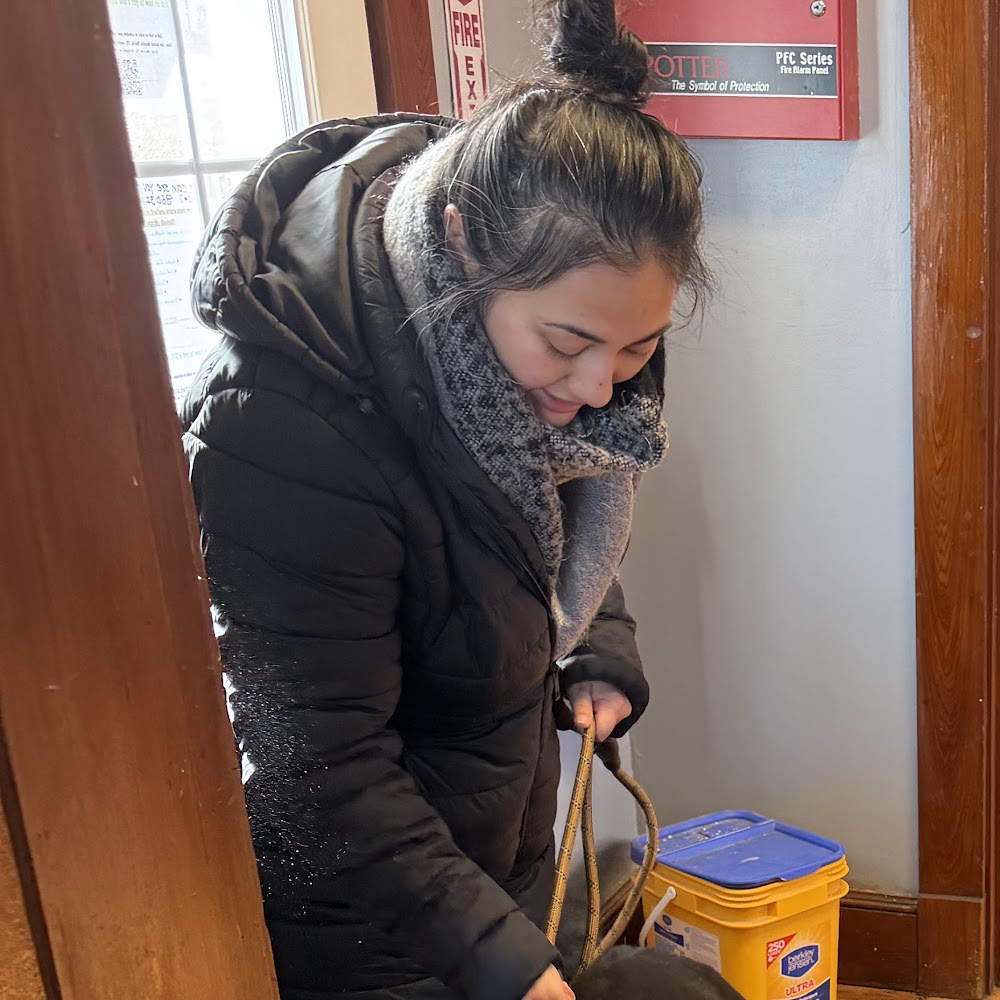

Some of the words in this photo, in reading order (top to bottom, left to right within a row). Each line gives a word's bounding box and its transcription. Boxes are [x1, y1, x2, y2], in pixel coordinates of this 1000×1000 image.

[452, 11, 480, 48] FIRE
[776, 51, 796, 65] PFC
[800, 52, 833, 66] Series
[780, 65, 793, 75] Fire
[793, 65, 811, 75] Alarm
[812, 66, 830, 75] Panel
[465, 55, 478, 111] EX
[672, 79, 686, 91] The
[689, 80, 717, 93] Symbol
[719, 81, 728, 92] of
[730, 81, 770, 93] Protection
[768, 940, 785, 951] 250
[785, 980, 815, 995] ULTRA
